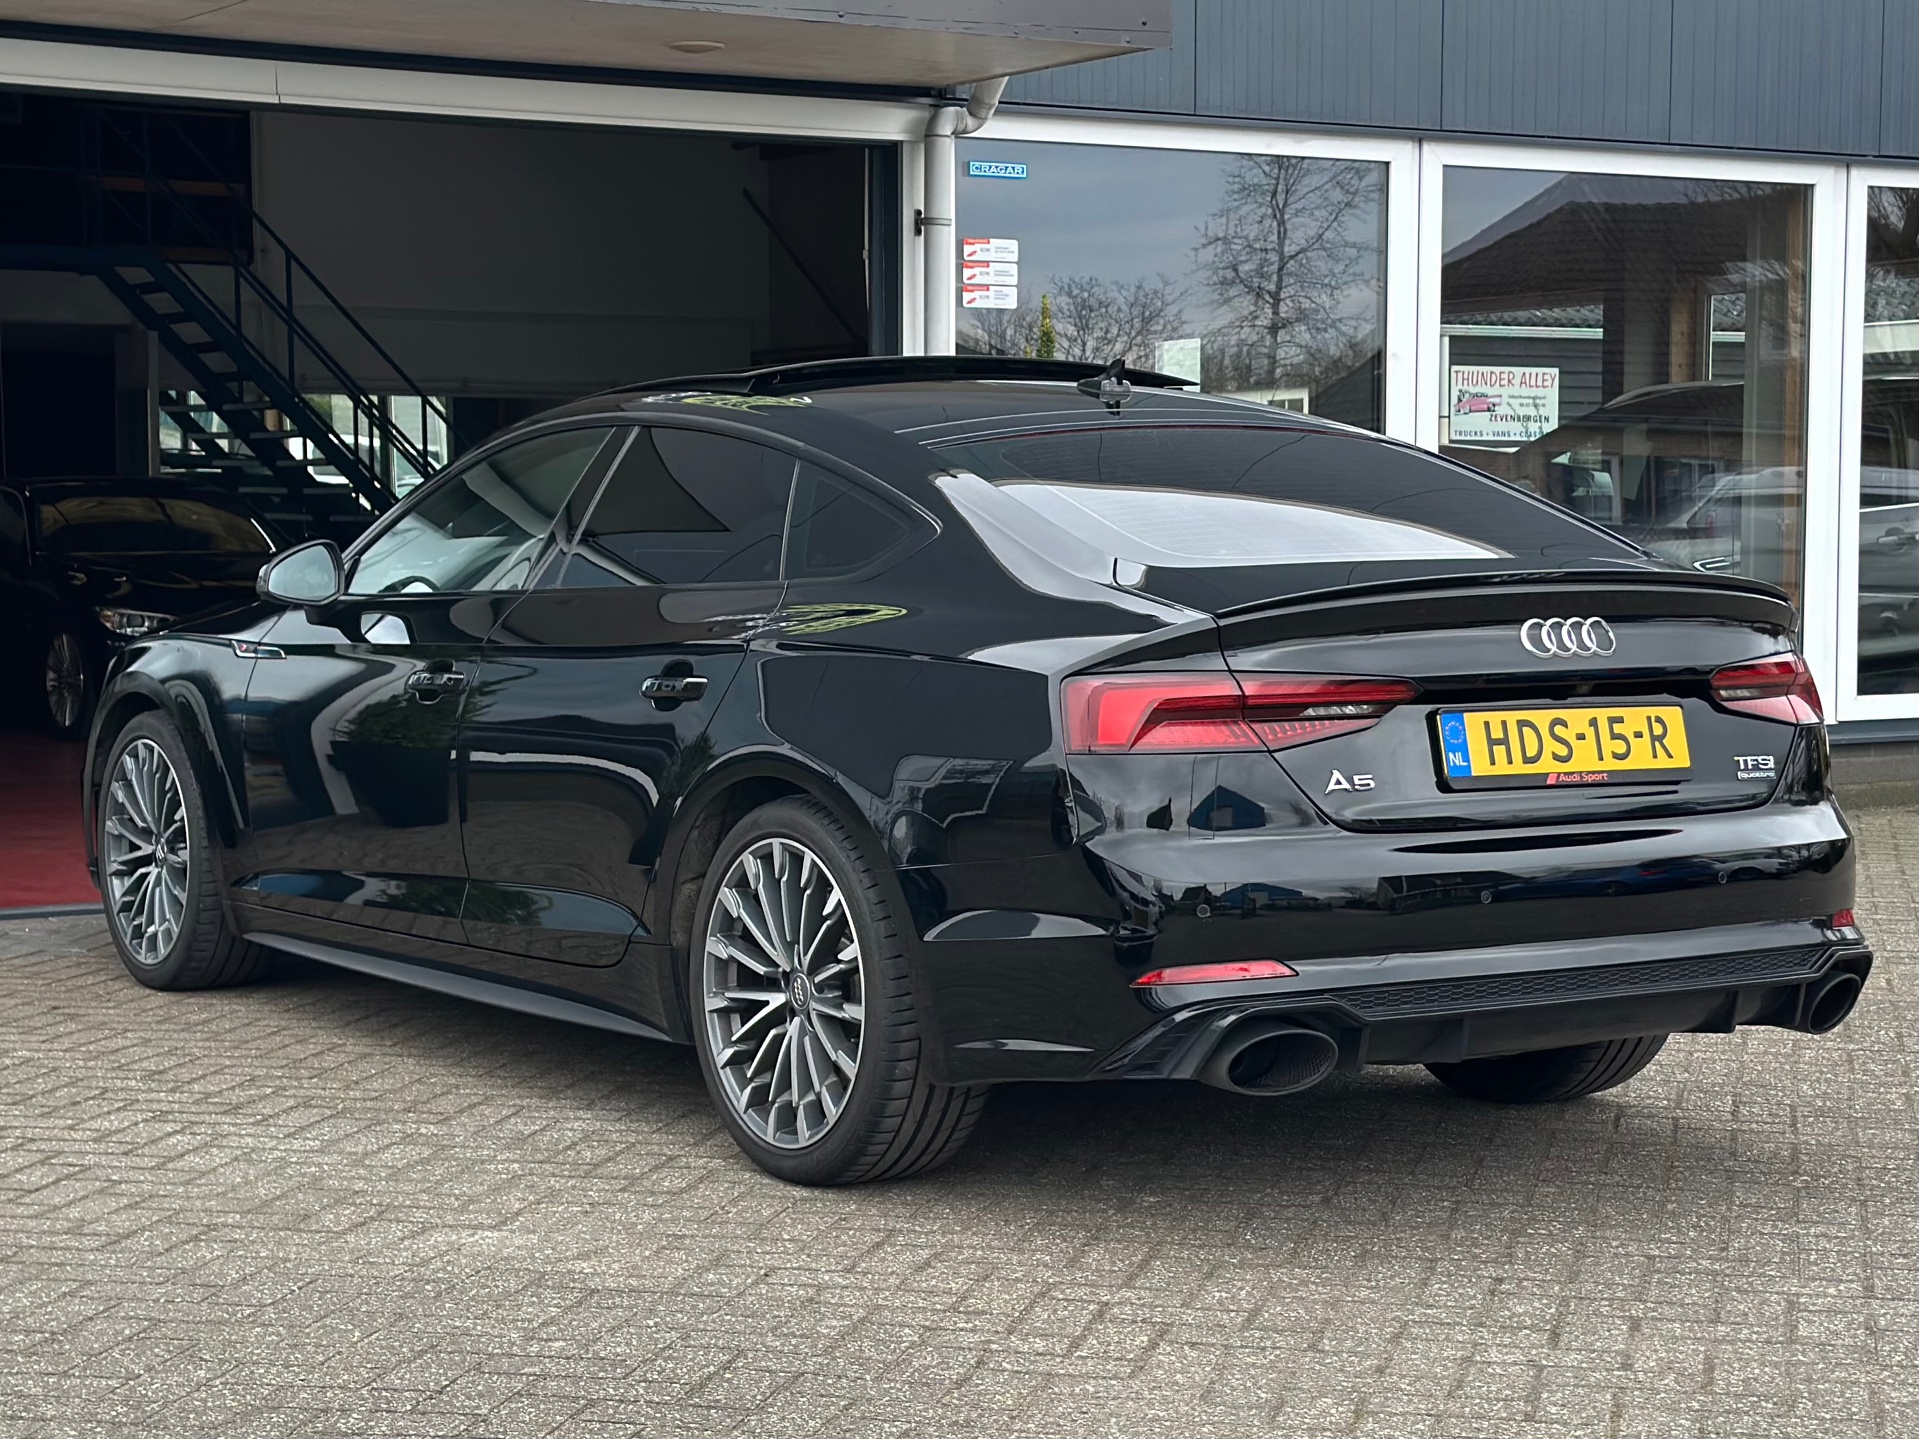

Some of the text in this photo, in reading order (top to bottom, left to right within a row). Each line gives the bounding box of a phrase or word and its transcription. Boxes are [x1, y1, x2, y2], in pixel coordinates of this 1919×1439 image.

[972, 164, 1024, 175] CRAGAR
[1454, 370, 1557, 389] THUNDER ALLEY
[1489, 414, 1550, 424] ZEVENBERGEN
[1454, 430, 1484, 438] TRUCKS
[1483, 715, 1674, 766] HDS-15-R
[1449, 752, 1468, 766] NL
[1733, 755, 1775, 769] TFSI
[1558, 772, 1608, 782] Audi Sport
[1740, 771, 1775, 779] quattro
[1324, 769, 1376, 794] A5
